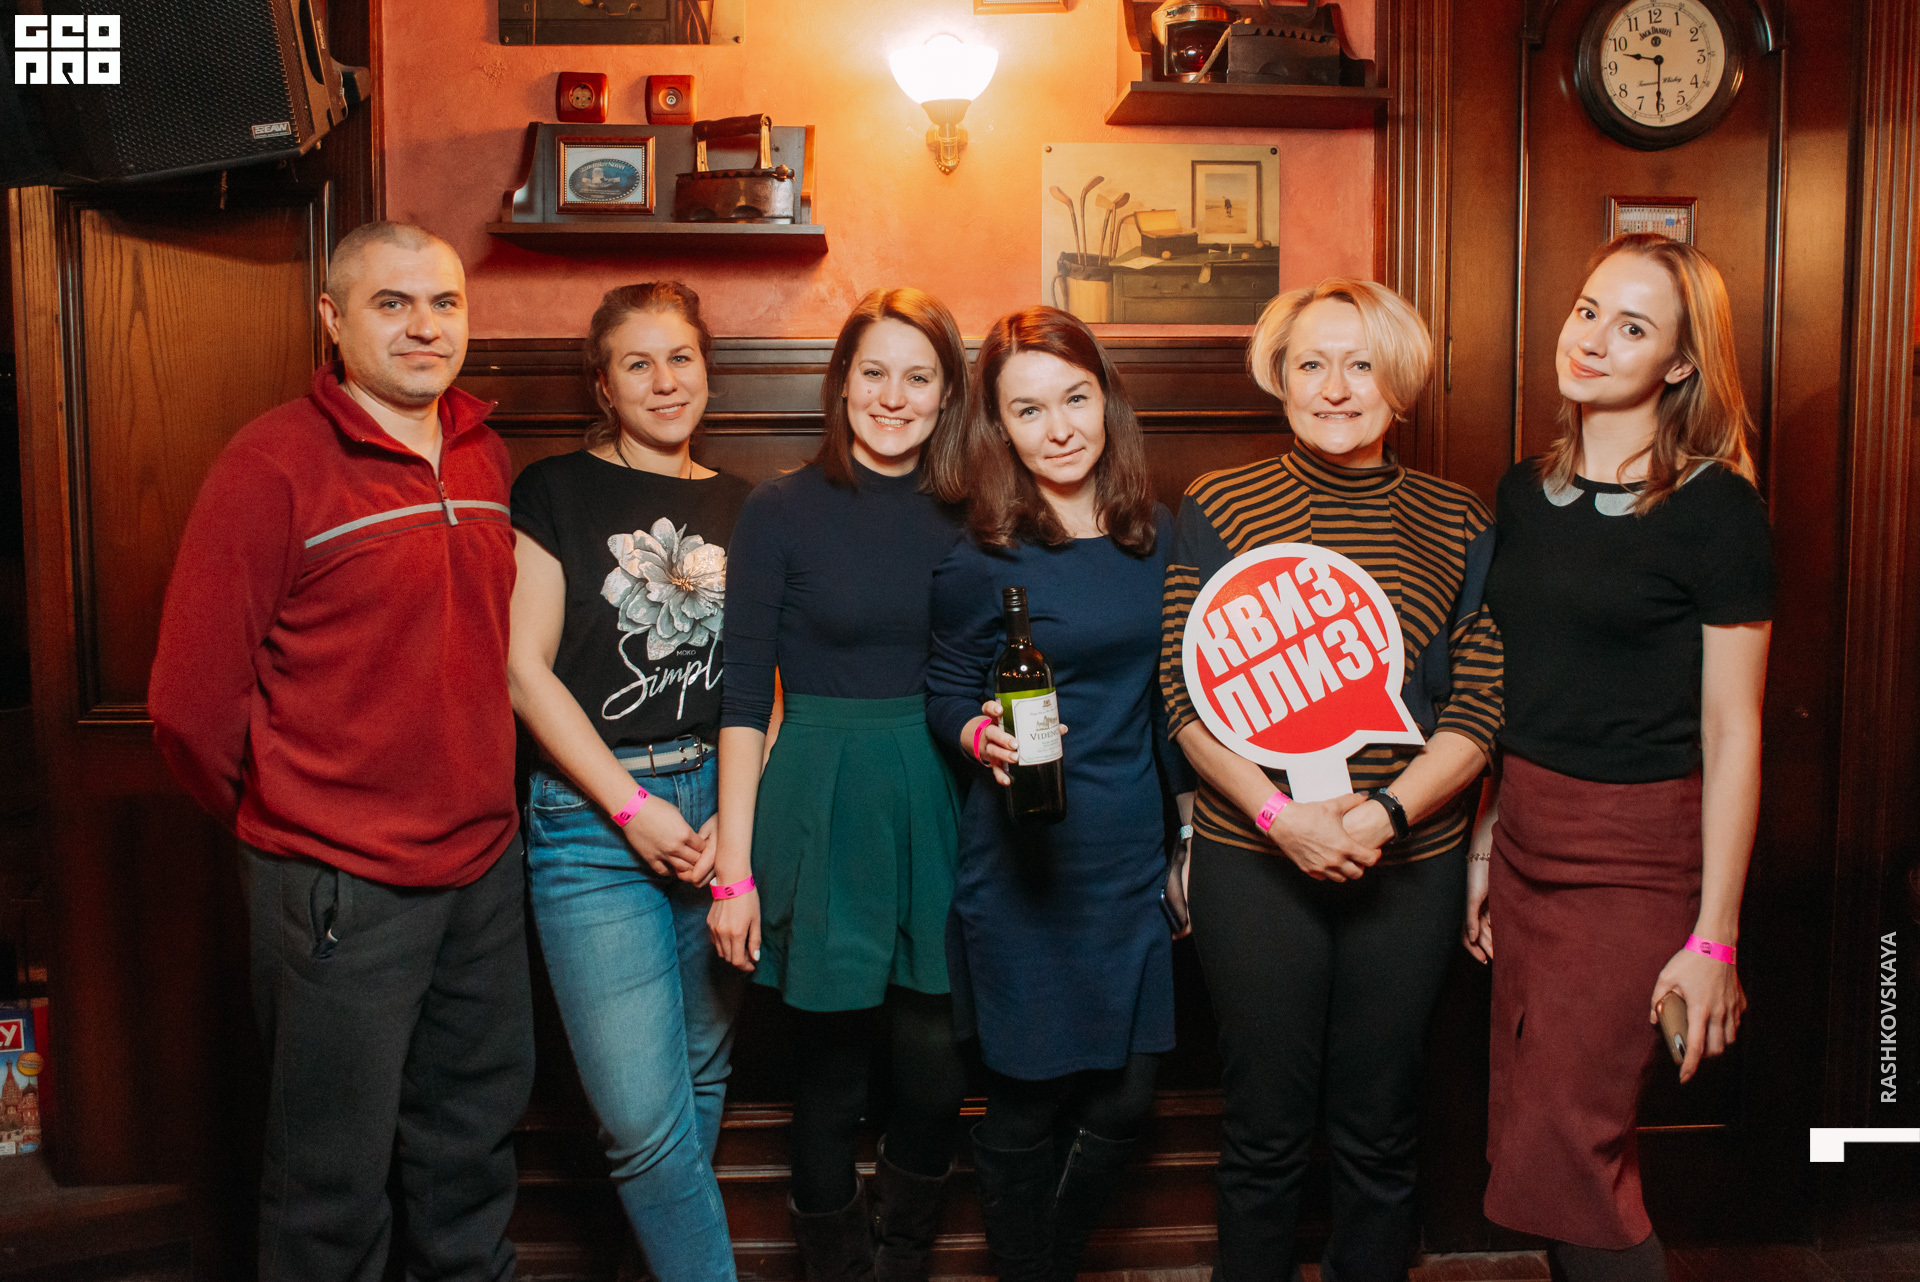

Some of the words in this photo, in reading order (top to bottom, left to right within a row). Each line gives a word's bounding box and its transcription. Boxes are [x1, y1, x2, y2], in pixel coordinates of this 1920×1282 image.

[1648, 8, 1662, 24] 12
[1674, 12, 1680, 26] 1
[1628, 17, 1639, 32] 11
[1690, 27, 1699, 42] 2
[1613, 36, 1628, 52] 10
[1697, 49, 1706, 64] 3
[1609, 61, 1618, 76] 9
[1690, 73, 1699, 88] 4
[1619, 83, 1628, 99] 8
[1676, 90, 1685, 105] 5
[1636, 96, 1645, 111] 7
[1656, 97, 1665, 113] 6
[1197, 557, 1360, 678] КВИЗ,
[602, 624, 723, 720] Simpl
[1212, 604, 1391, 741] ПЛИЗ!
[0, 1024, 18, 1047] Y
